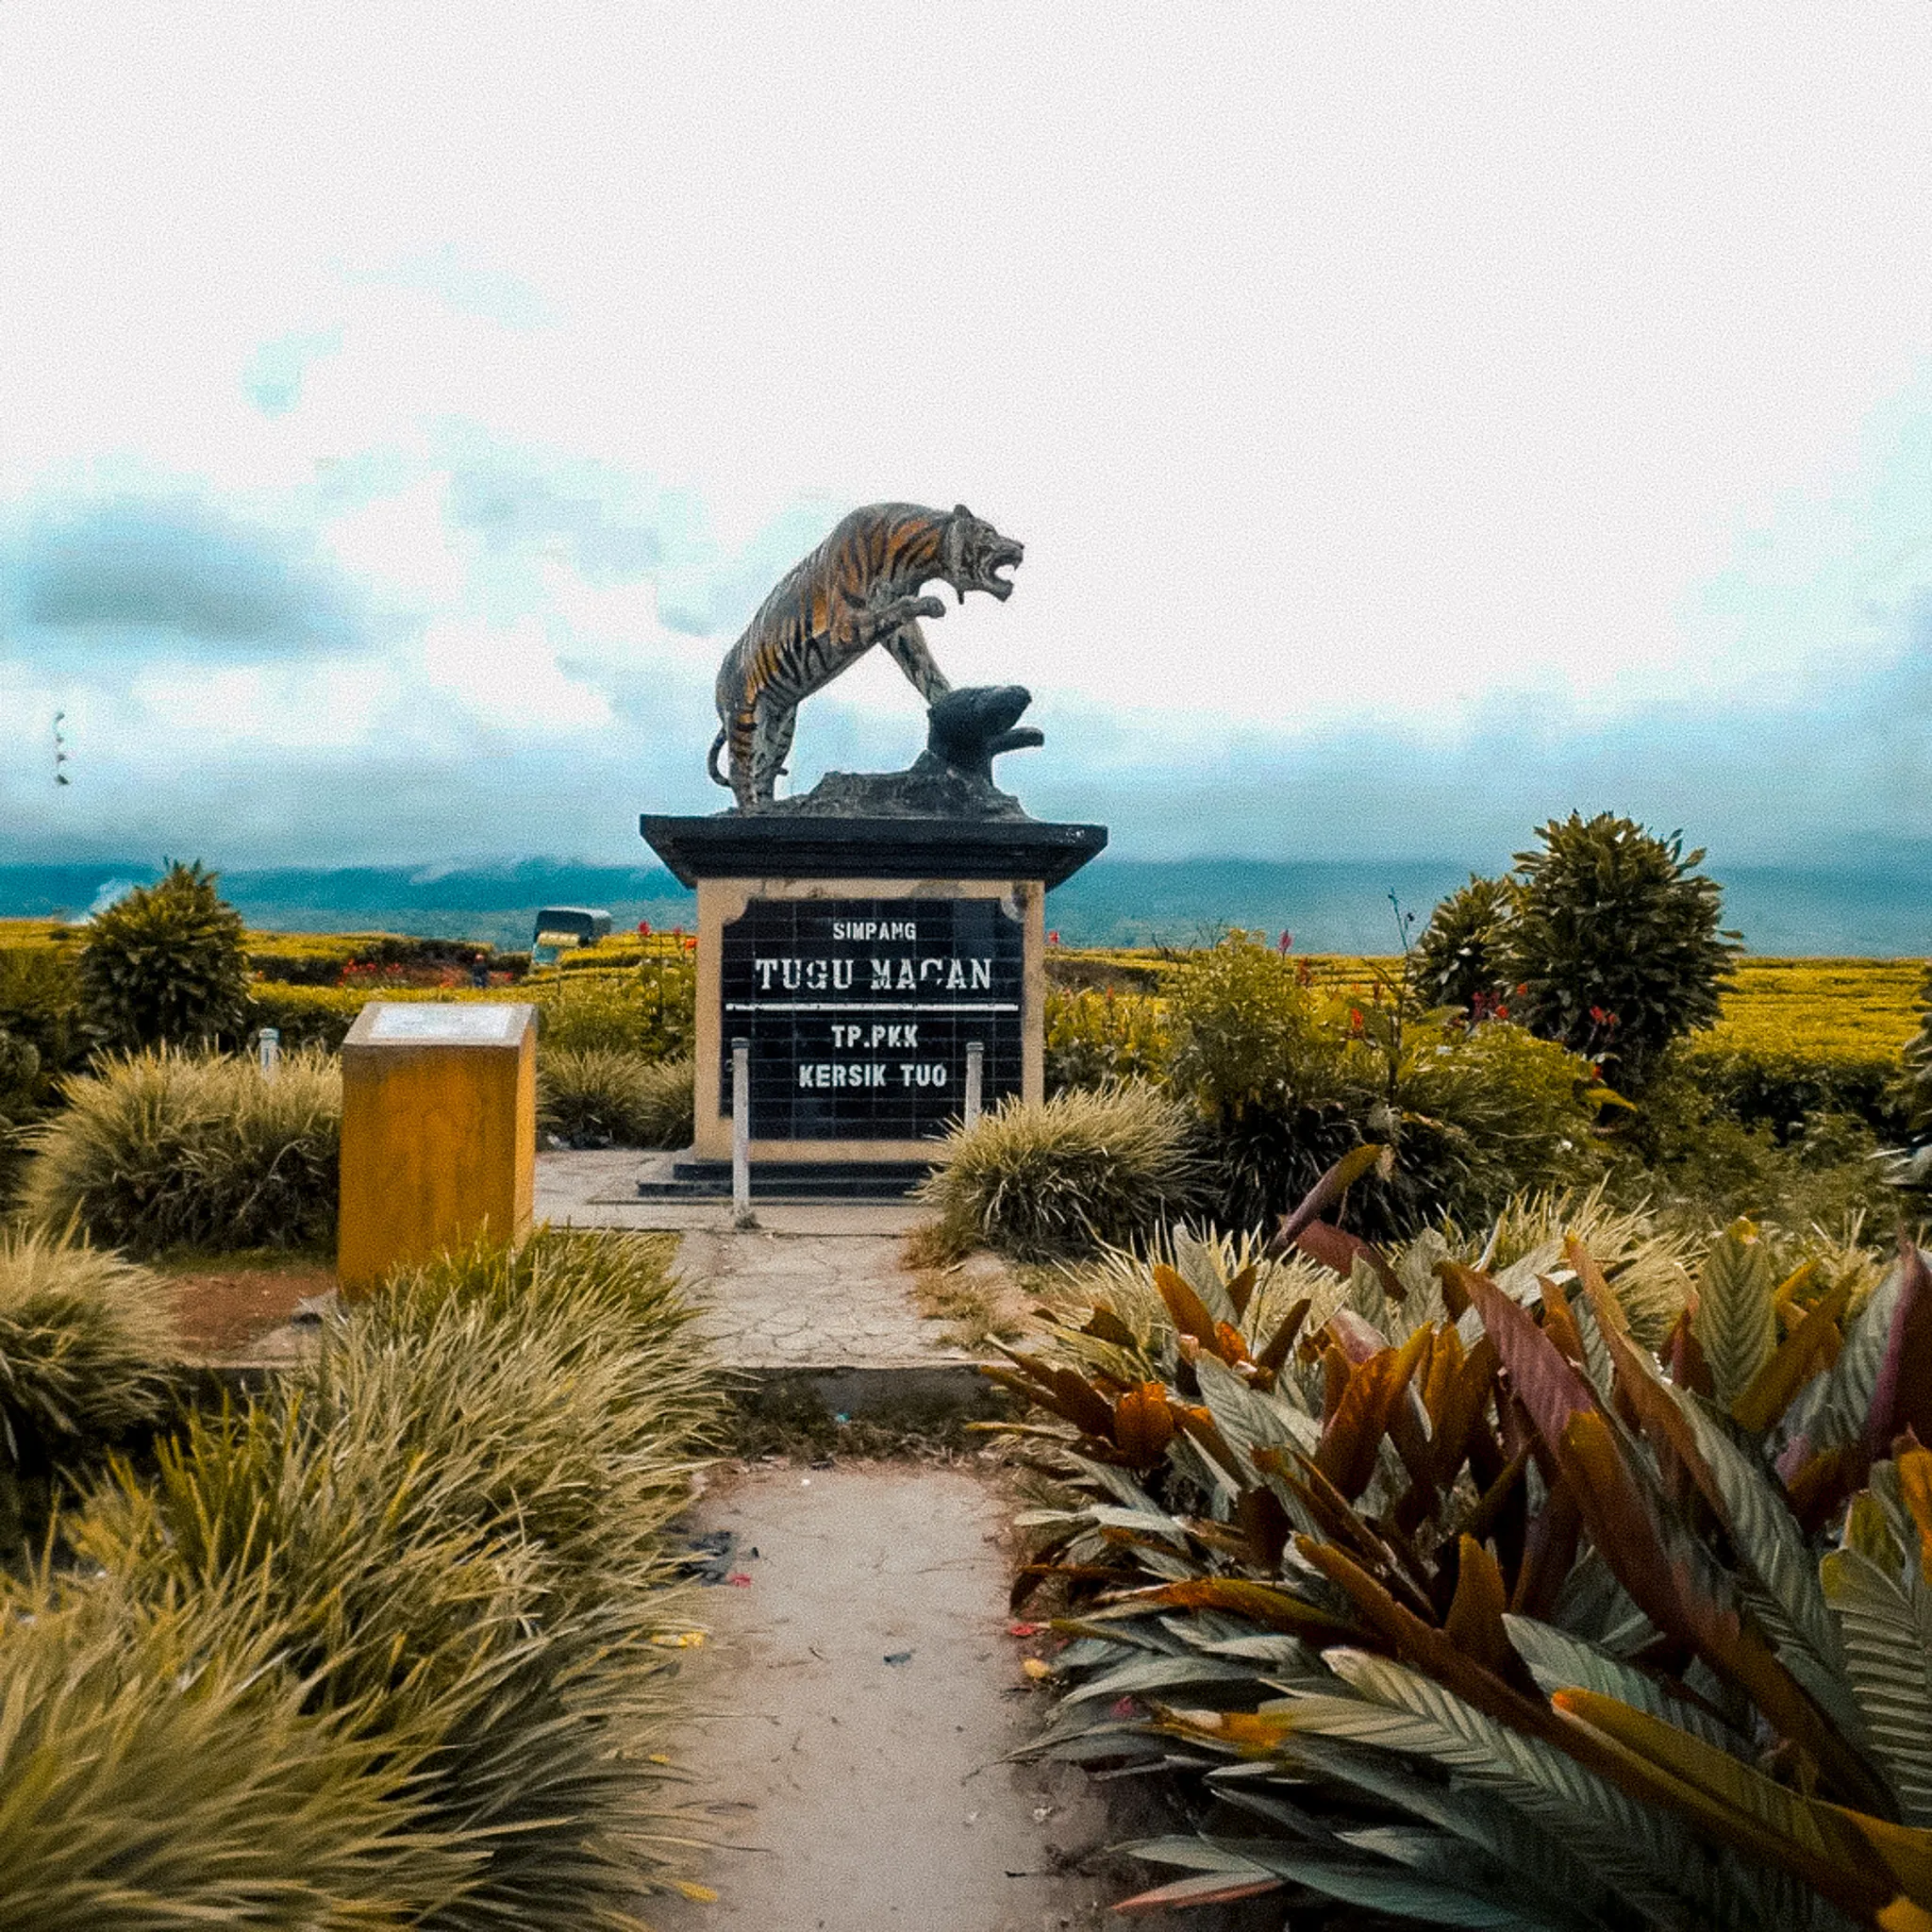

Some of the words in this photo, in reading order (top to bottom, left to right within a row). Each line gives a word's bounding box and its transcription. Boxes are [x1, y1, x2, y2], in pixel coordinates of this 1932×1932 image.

[833, 922, 917, 941] SIMPANG
[755, 958, 854, 991] TUGU
[870, 958, 991, 991] MACAN
[831, 1025, 919, 1048] TP.PKK
[798, 1064, 887, 1089] KERSIK
[901, 1064, 947, 1088] TUO
